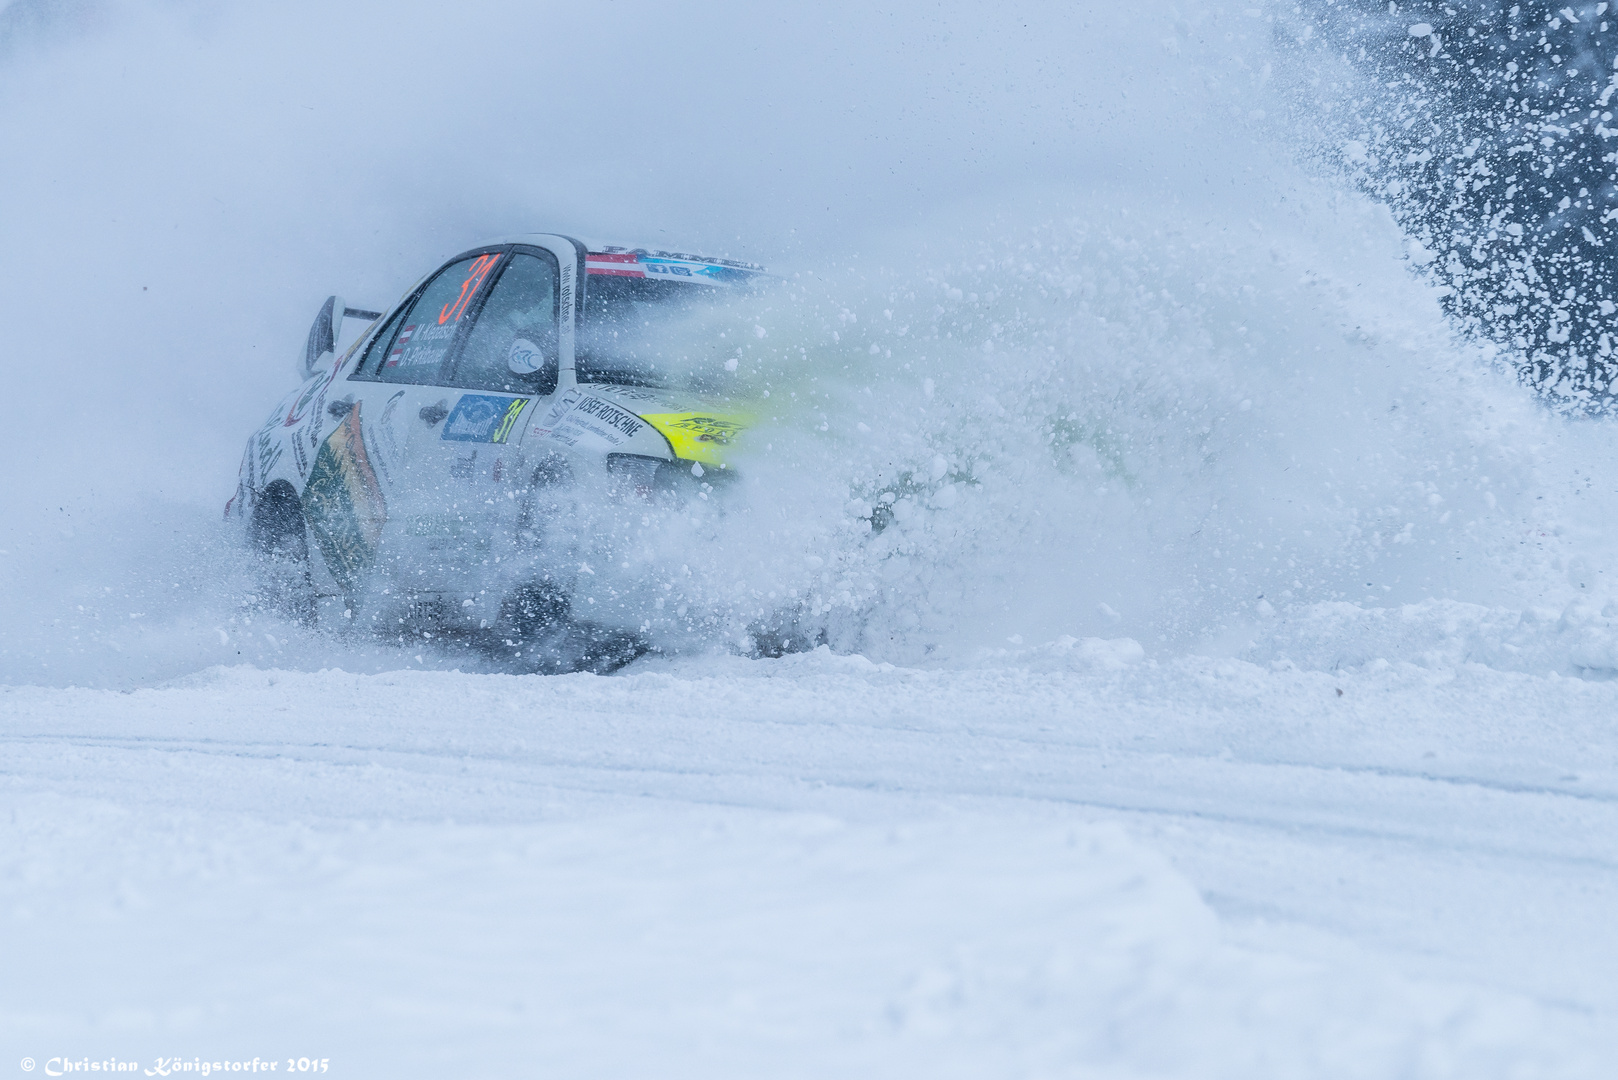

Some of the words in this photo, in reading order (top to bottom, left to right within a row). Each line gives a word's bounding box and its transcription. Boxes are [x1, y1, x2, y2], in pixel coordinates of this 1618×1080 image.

[438, 252, 501, 325] 31
[493, 398, 529, 443] 31
[573, 396, 605, 414] JOSEF
[595, 405, 644, 438] ROTSCHNE
